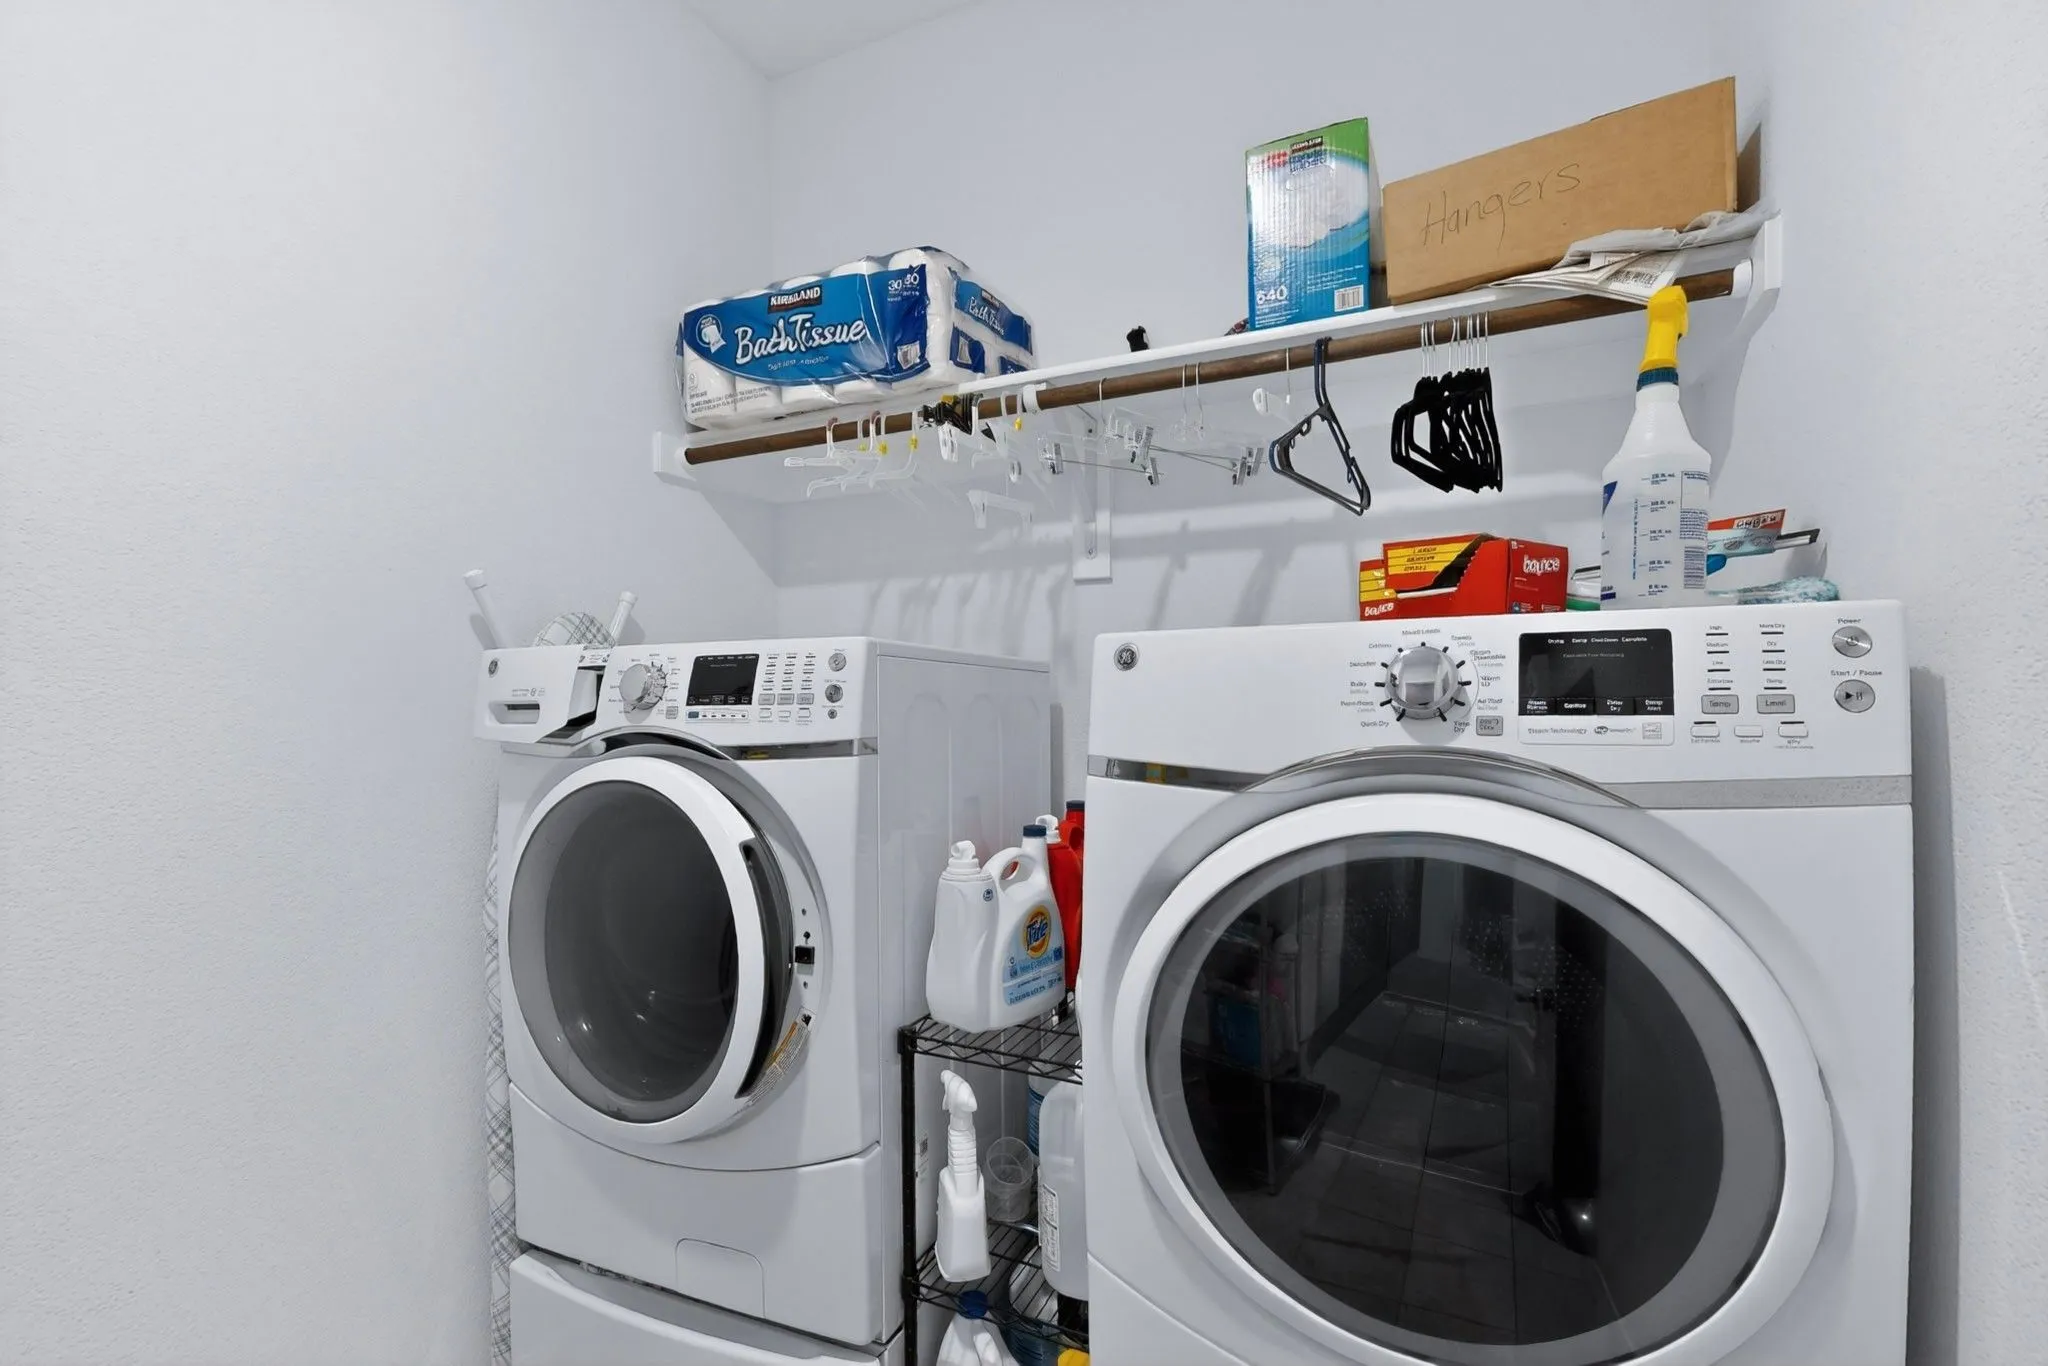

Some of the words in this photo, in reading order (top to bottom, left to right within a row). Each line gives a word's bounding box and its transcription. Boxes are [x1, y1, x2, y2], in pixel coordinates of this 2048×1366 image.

[1421, 163, 1582, 251] Hangers
[770, 286, 821, 306] KIRKLAND
[734, 317, 798, 365] Bath
[788, 313, 867, 352] Tissue
[1522, 554, 1561, 577] bounce
[1026, 918, 1048, 951] Tide
